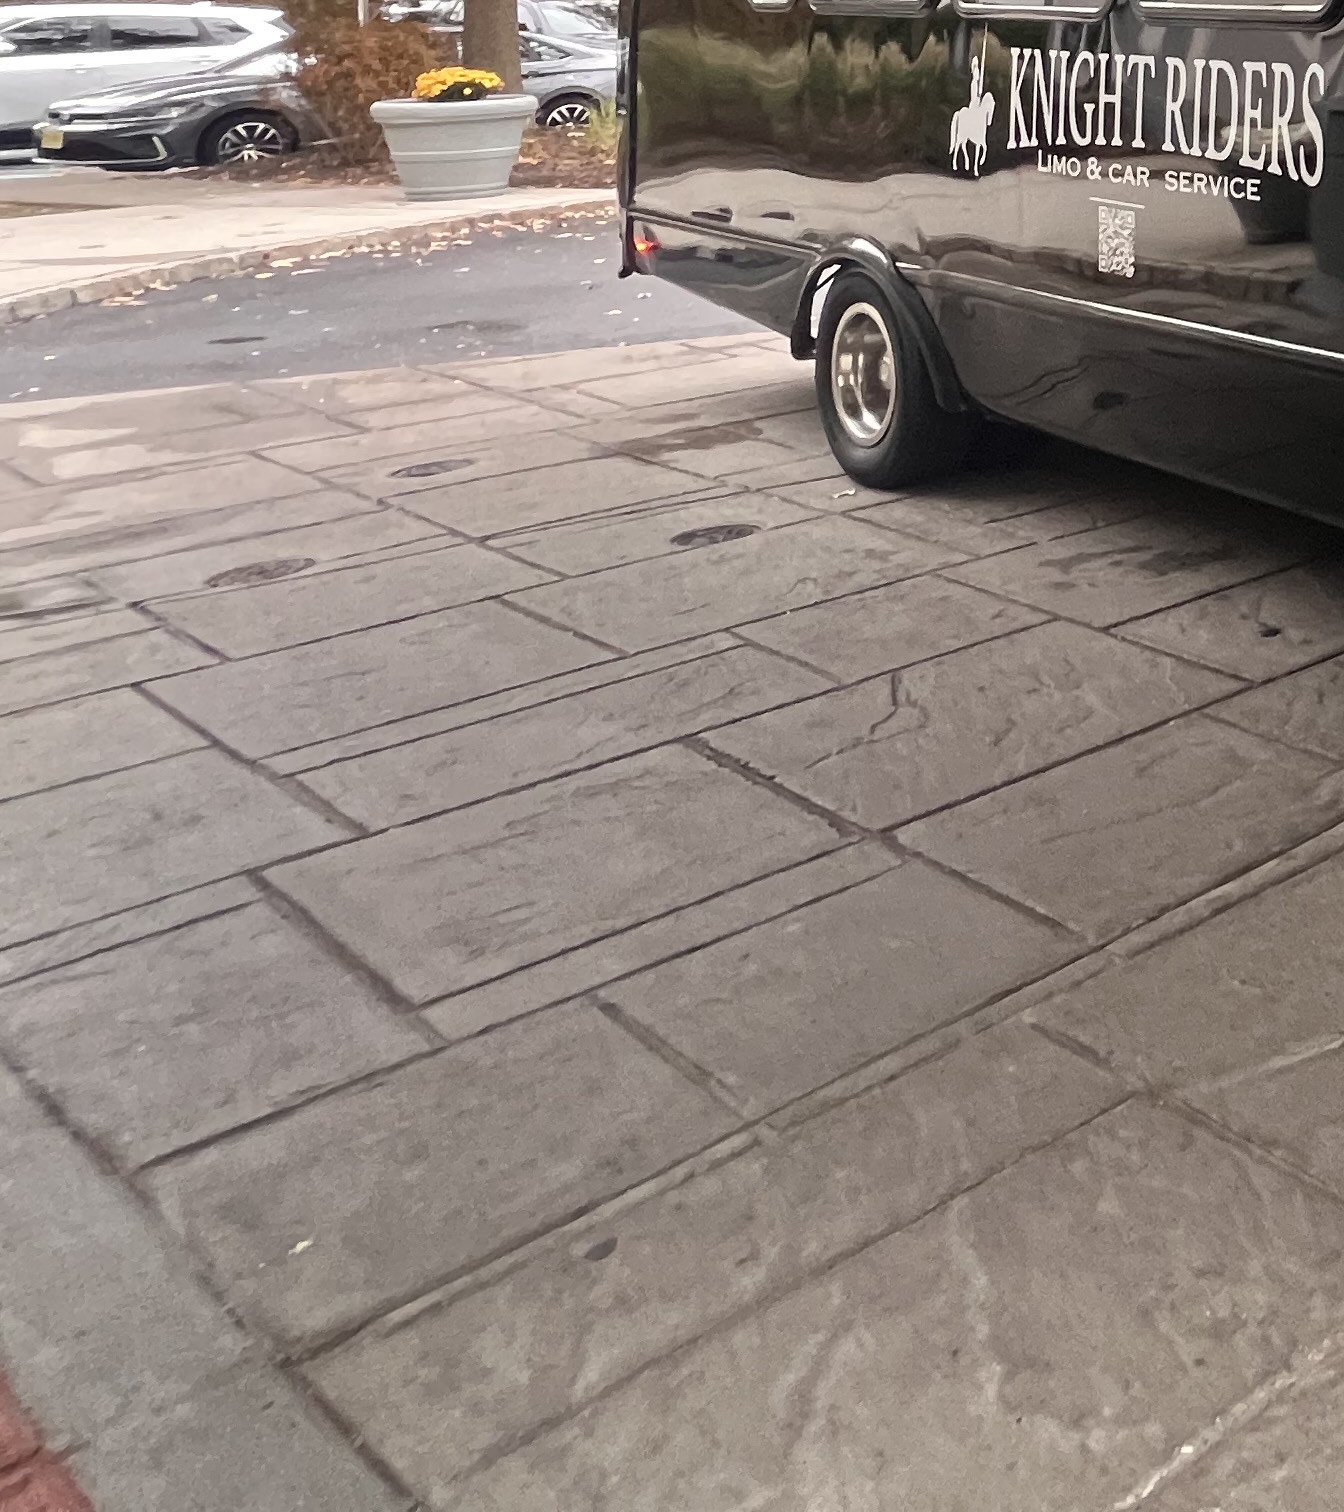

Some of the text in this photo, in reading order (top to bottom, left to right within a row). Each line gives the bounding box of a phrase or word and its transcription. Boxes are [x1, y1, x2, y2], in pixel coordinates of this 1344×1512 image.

[1006, 46, 1325, 187] KNIGHT RIDERS
[1037, 150, 1261, 202] LIMO & CAR SERVICE
